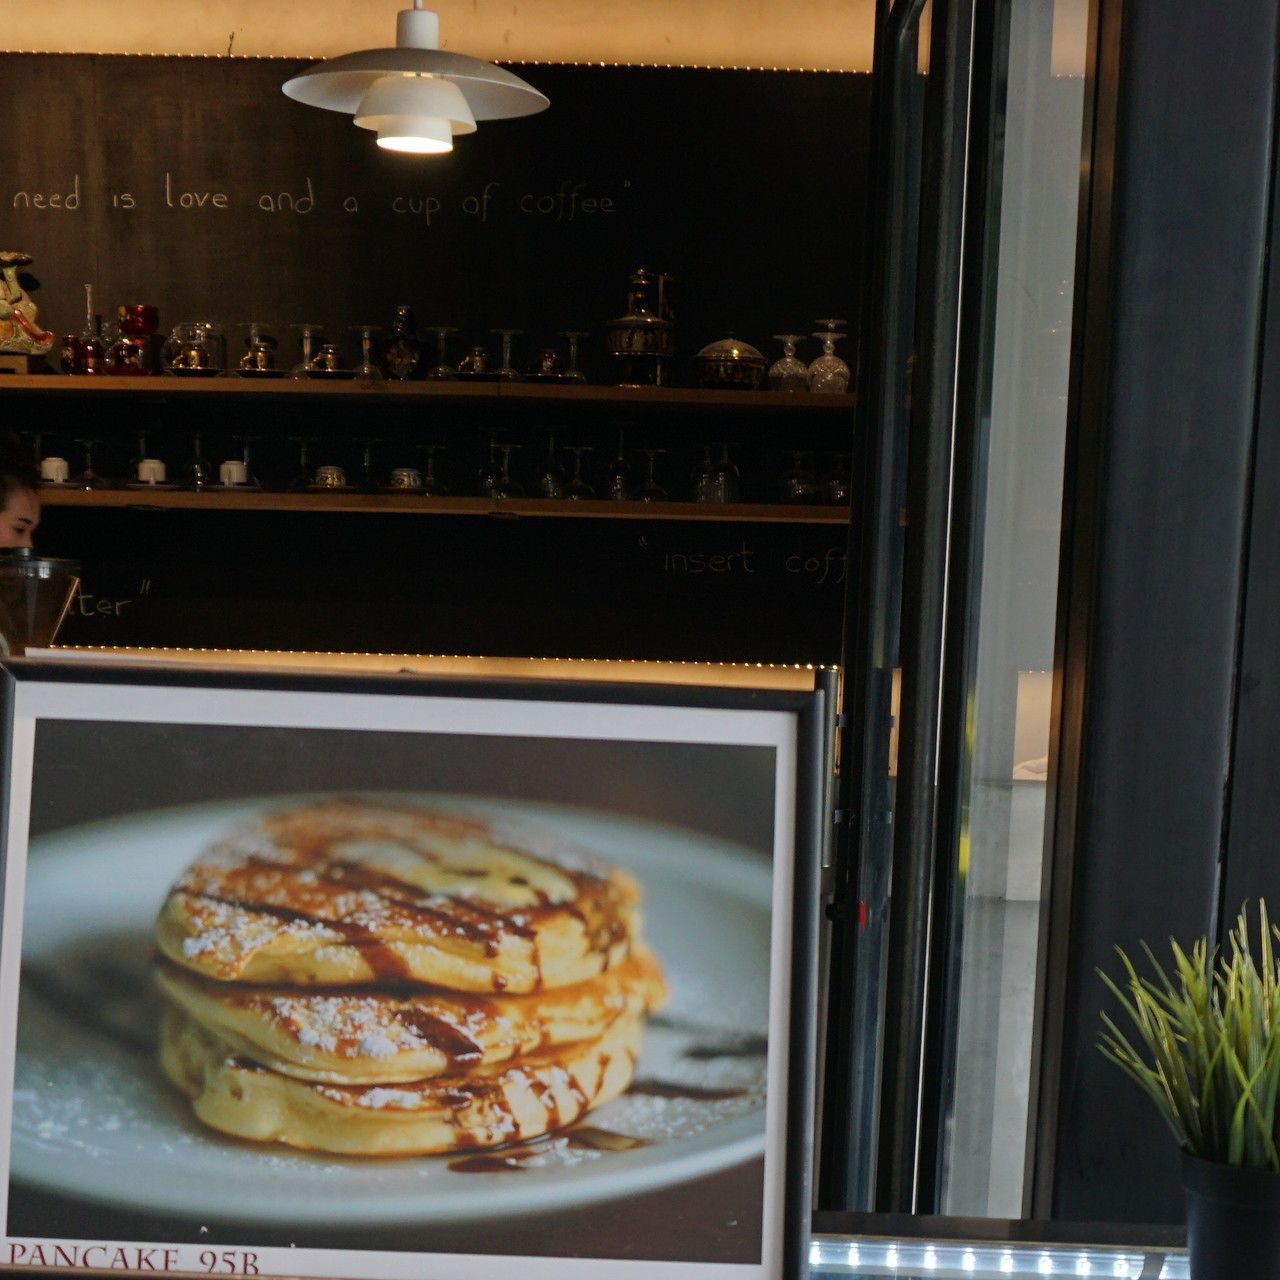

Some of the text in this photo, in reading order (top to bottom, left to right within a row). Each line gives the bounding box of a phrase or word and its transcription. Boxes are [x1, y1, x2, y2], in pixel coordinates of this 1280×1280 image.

[12, 173, 82, 210] need
[112, 193, 136, 210] is
[165, 171, 230, 209] love
[258, 176, 316, 215] and
[342, 195, 360, 213] a
[391, 194, 442, 227] cup
[461, 181, 501, 223] of
[7, 1243, 261, 1275] PANCAKE 95B
